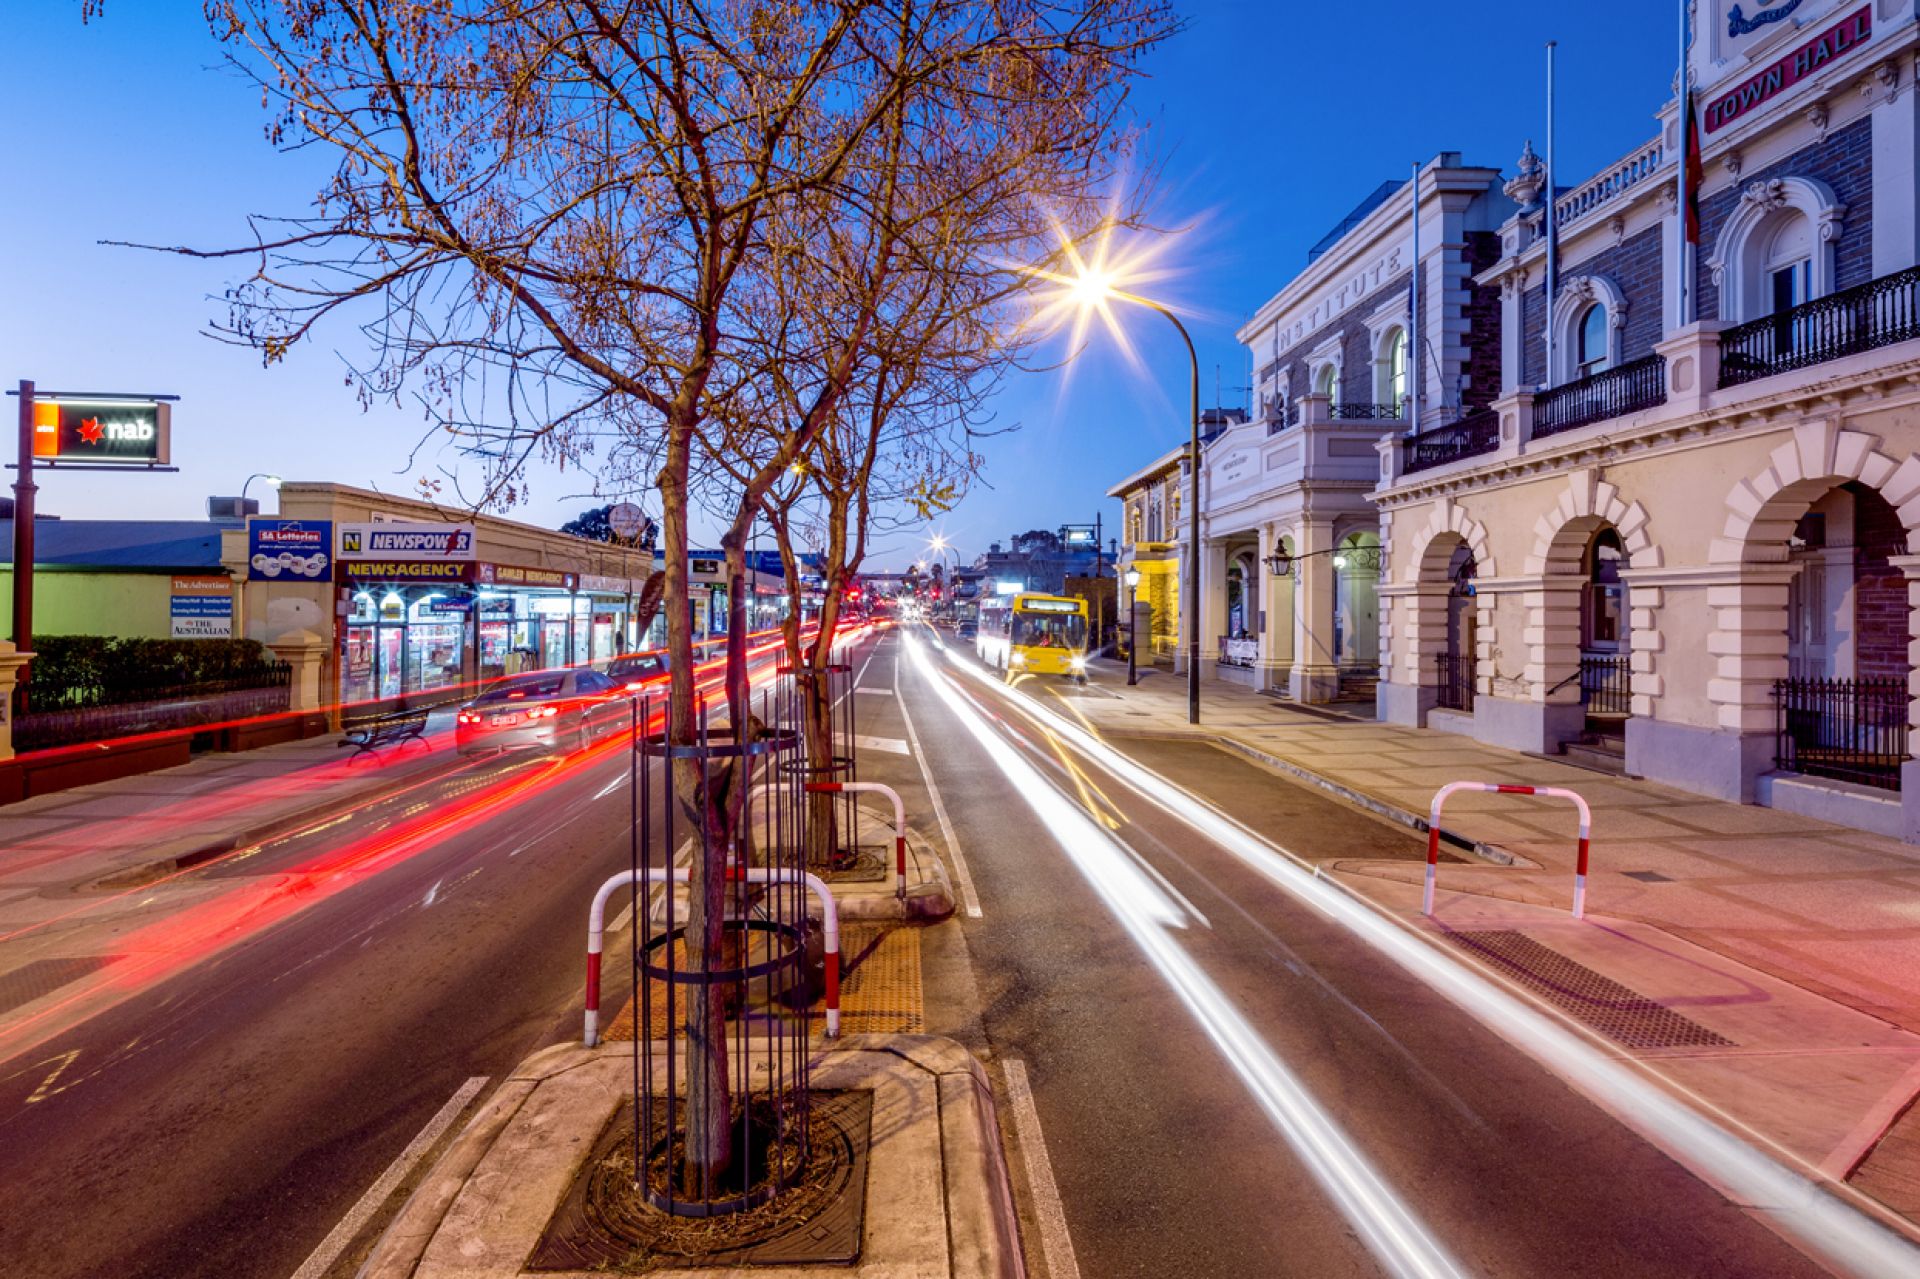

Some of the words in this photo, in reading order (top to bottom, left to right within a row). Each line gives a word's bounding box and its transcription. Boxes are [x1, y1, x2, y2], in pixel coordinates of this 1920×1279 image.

[1712, 65, 1783, 126] TOWN
[1794, 16, 1871, 77] HALL
[107, 419, 153, 440] nab
[262, 531, 274, 539] SA
[278, 531, 319, 539] Lotteries
[373, 533, 468, 549] NEWSPOWR
[348, 563, 464, 576] NEWSAGENCY
[175, 626, 230, 635] AUSTRALIAN
